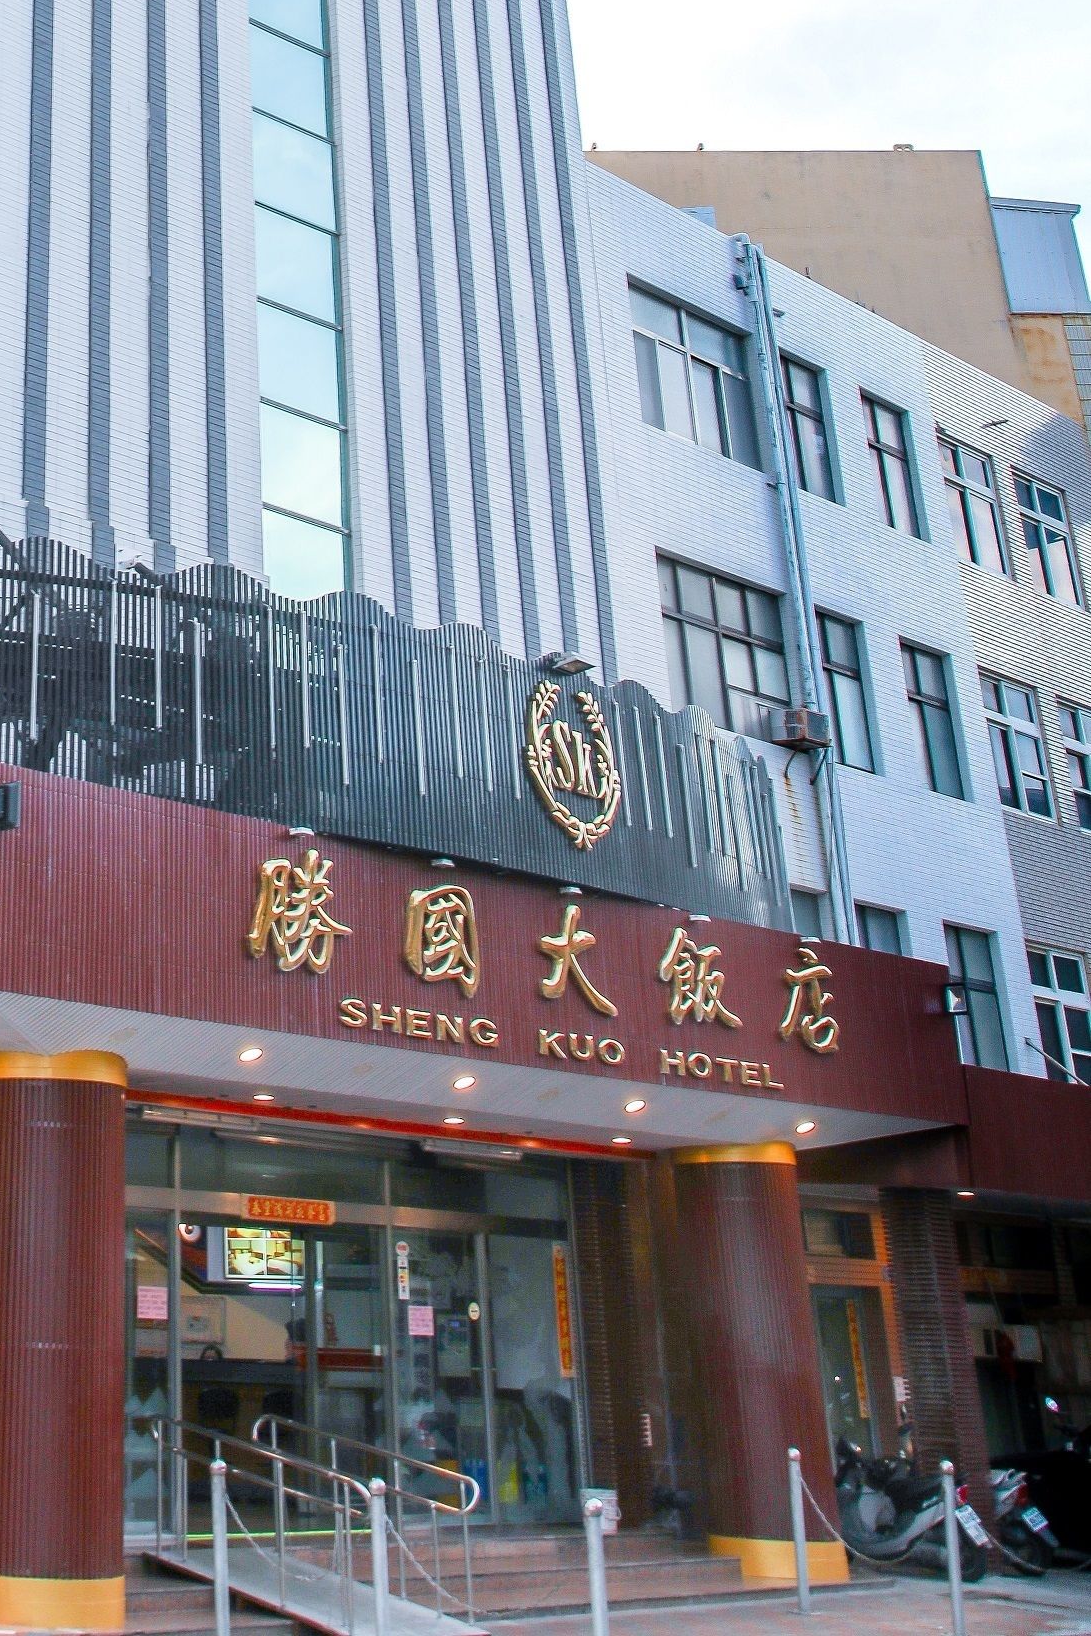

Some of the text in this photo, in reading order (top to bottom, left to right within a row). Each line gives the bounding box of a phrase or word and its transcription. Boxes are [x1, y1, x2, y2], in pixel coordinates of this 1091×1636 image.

[247, 849, 840, 1054] 勝國大飯店
[338, 997, 785, 1091] SHENG KUO HOTEL
